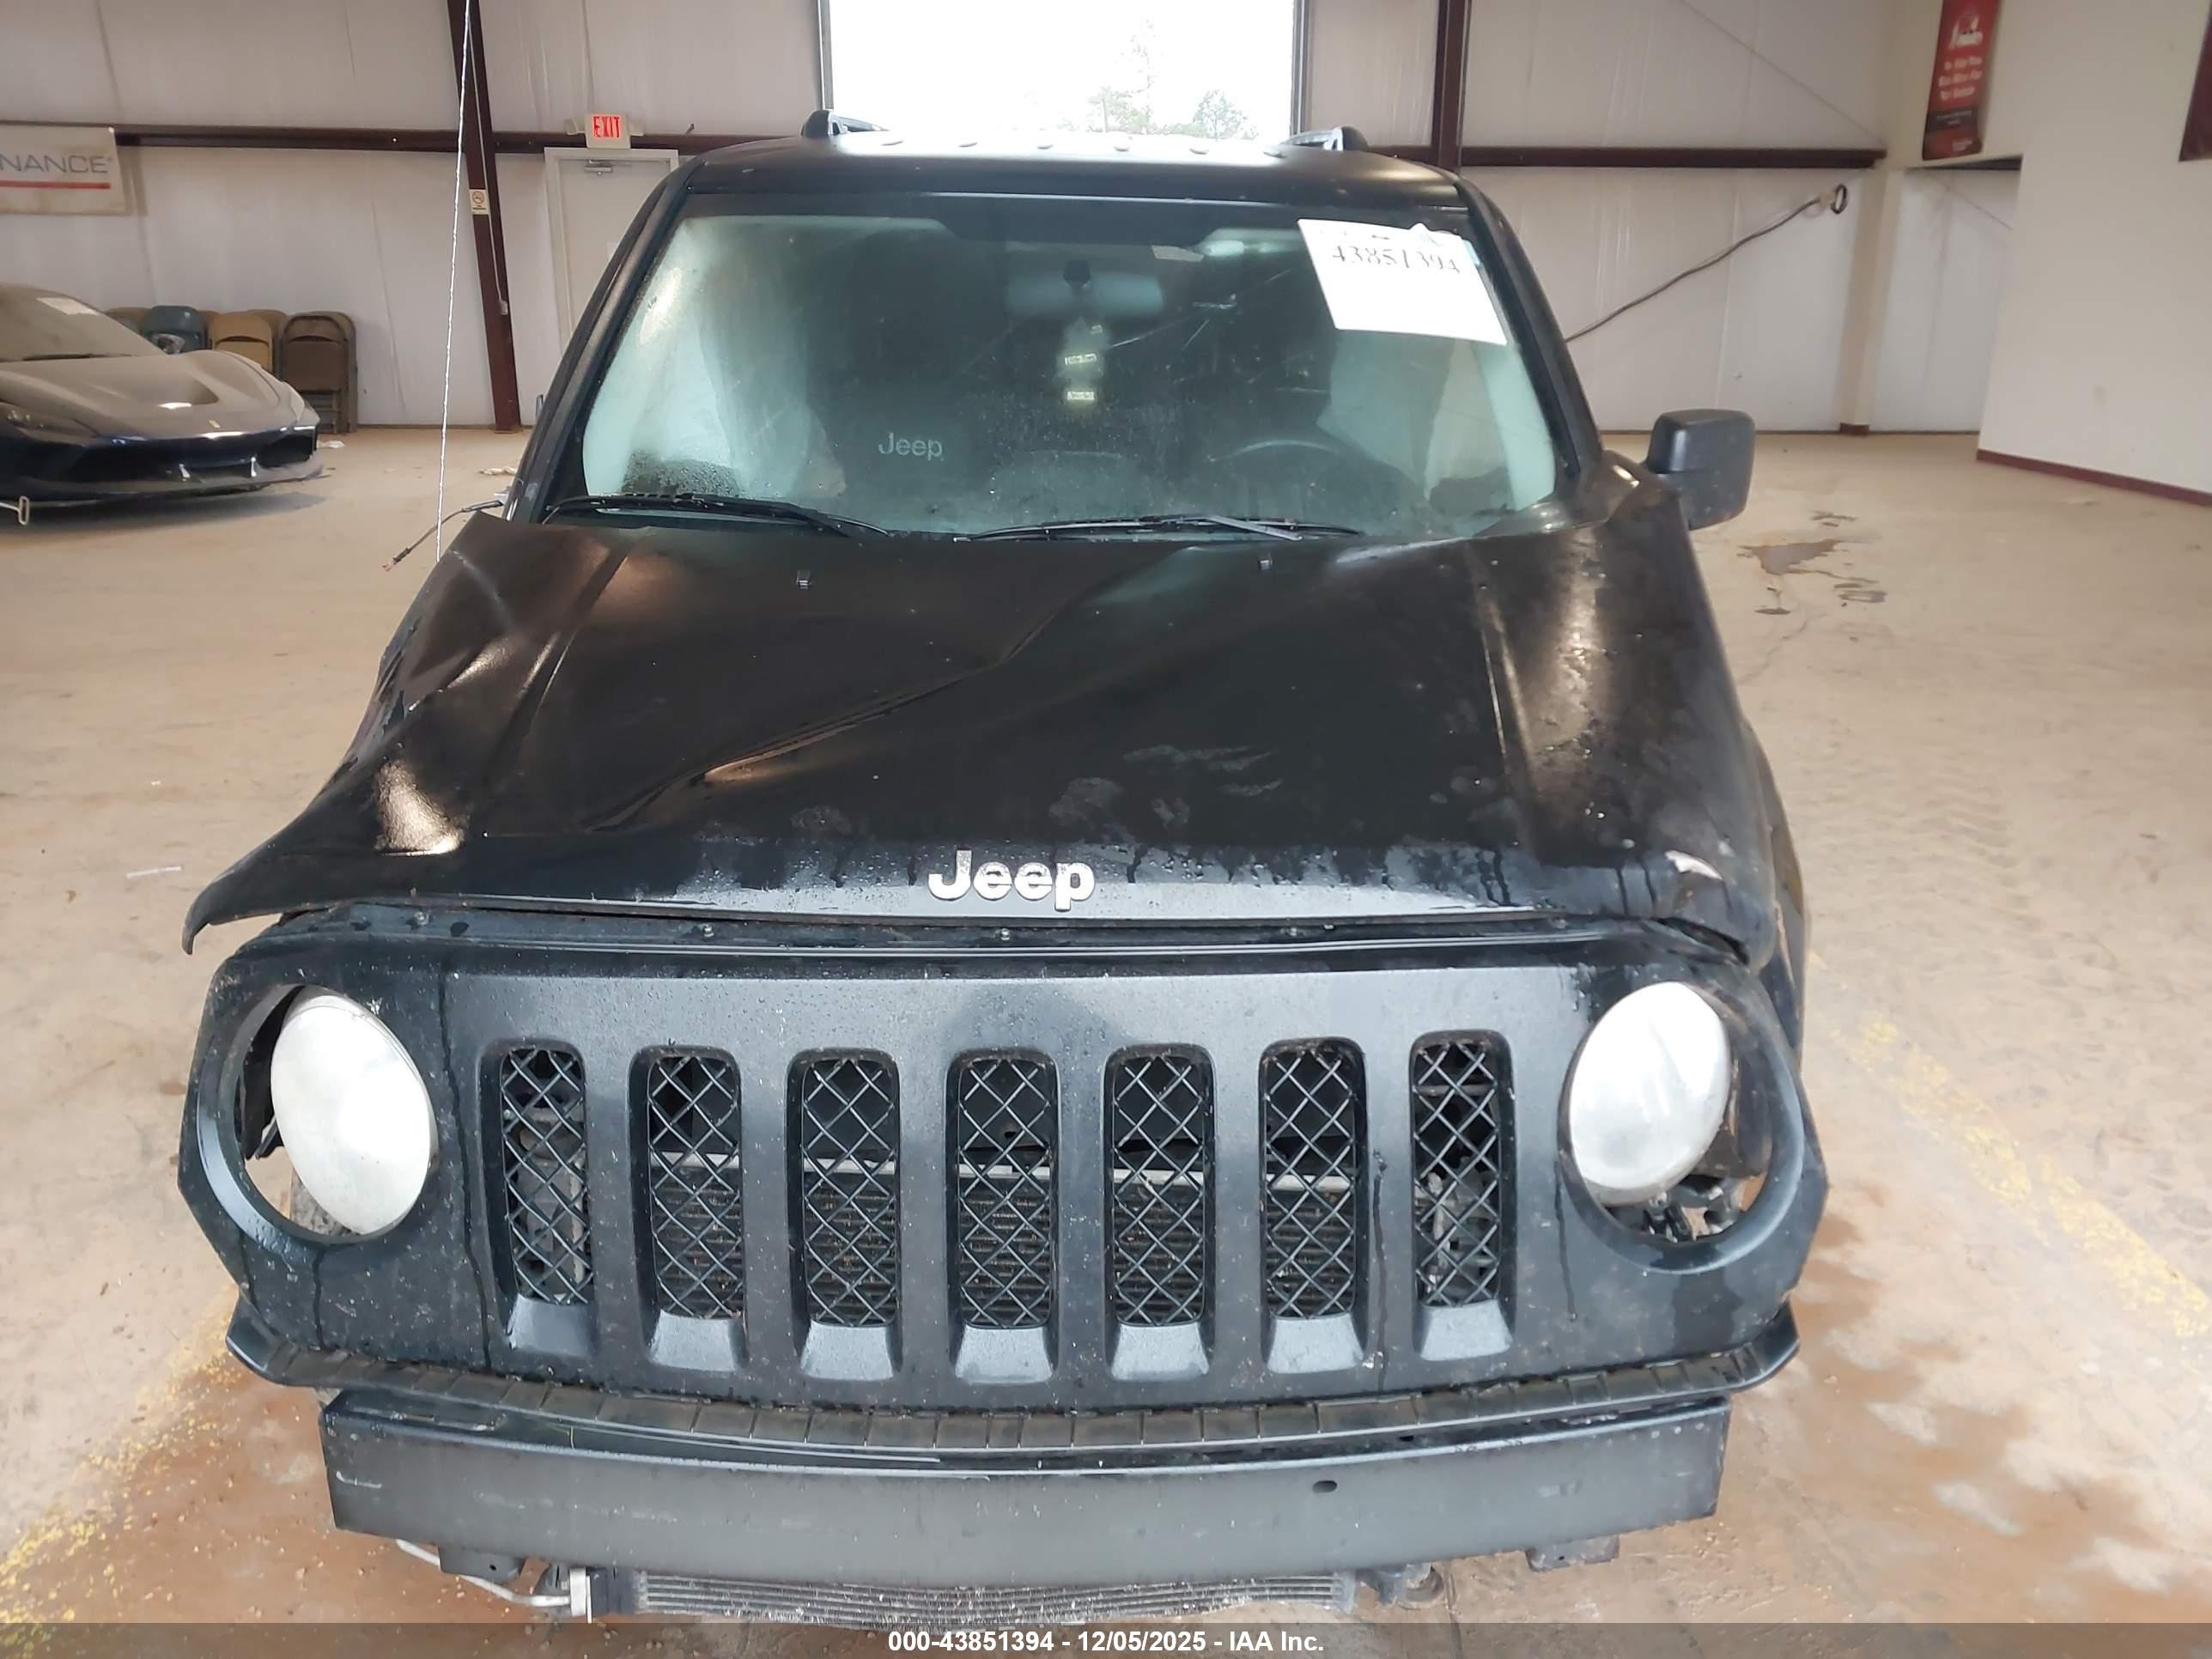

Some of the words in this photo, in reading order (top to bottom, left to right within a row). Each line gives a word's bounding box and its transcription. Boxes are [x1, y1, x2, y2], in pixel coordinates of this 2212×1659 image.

[592, 116, 620, 137] EXIT
[878, 432, 943, 461] Jeep
[928, 849, 1095, 912] Jeep
